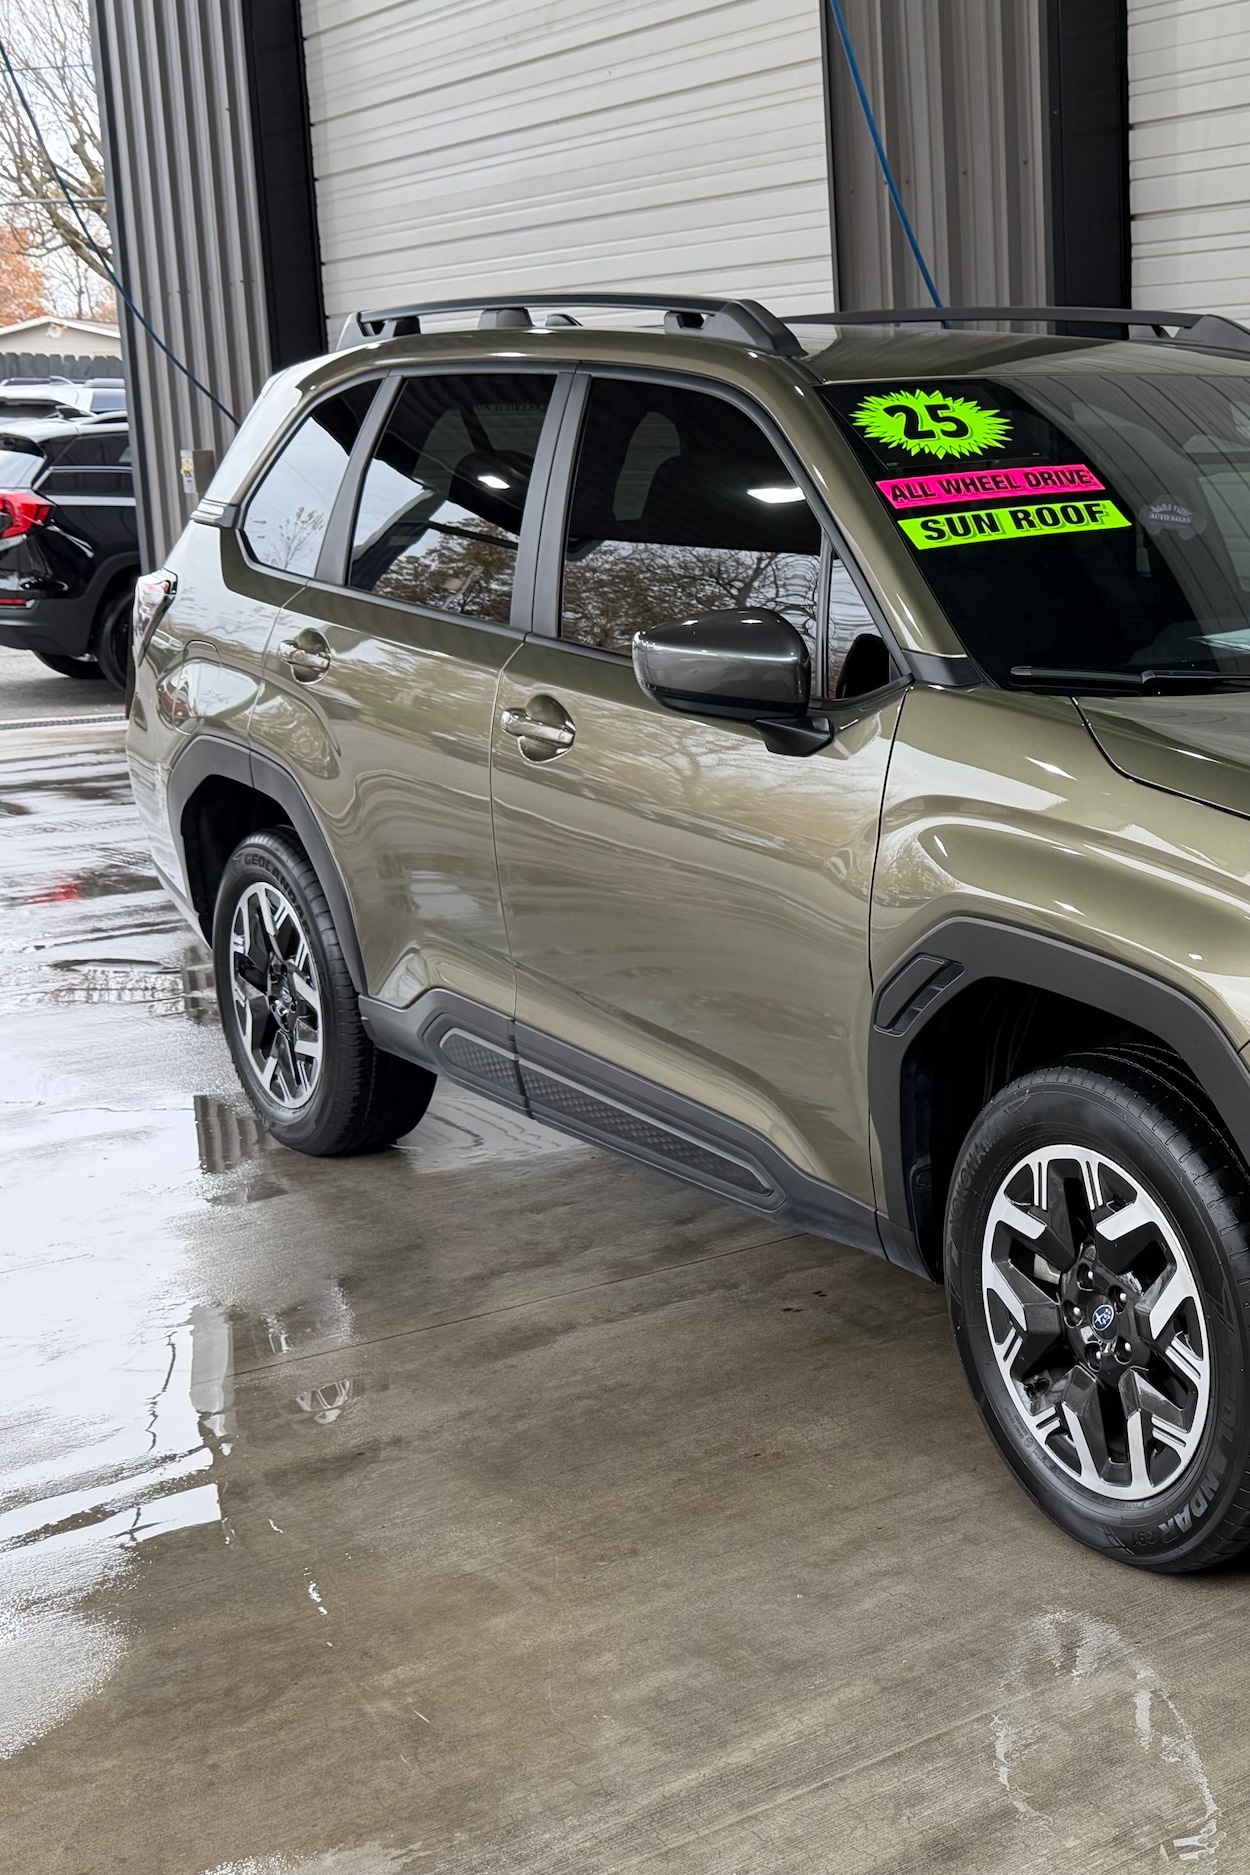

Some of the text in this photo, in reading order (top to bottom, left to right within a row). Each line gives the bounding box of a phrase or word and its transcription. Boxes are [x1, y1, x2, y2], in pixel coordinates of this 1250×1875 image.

[883, 404, 969, 440] 25
[890, 469, 1092, 501] ALL WHEEL DRIVE
[920, 503, 1105, 541] SUN ROOF
[1149, 512, 1191, 523] AUTO SALES
